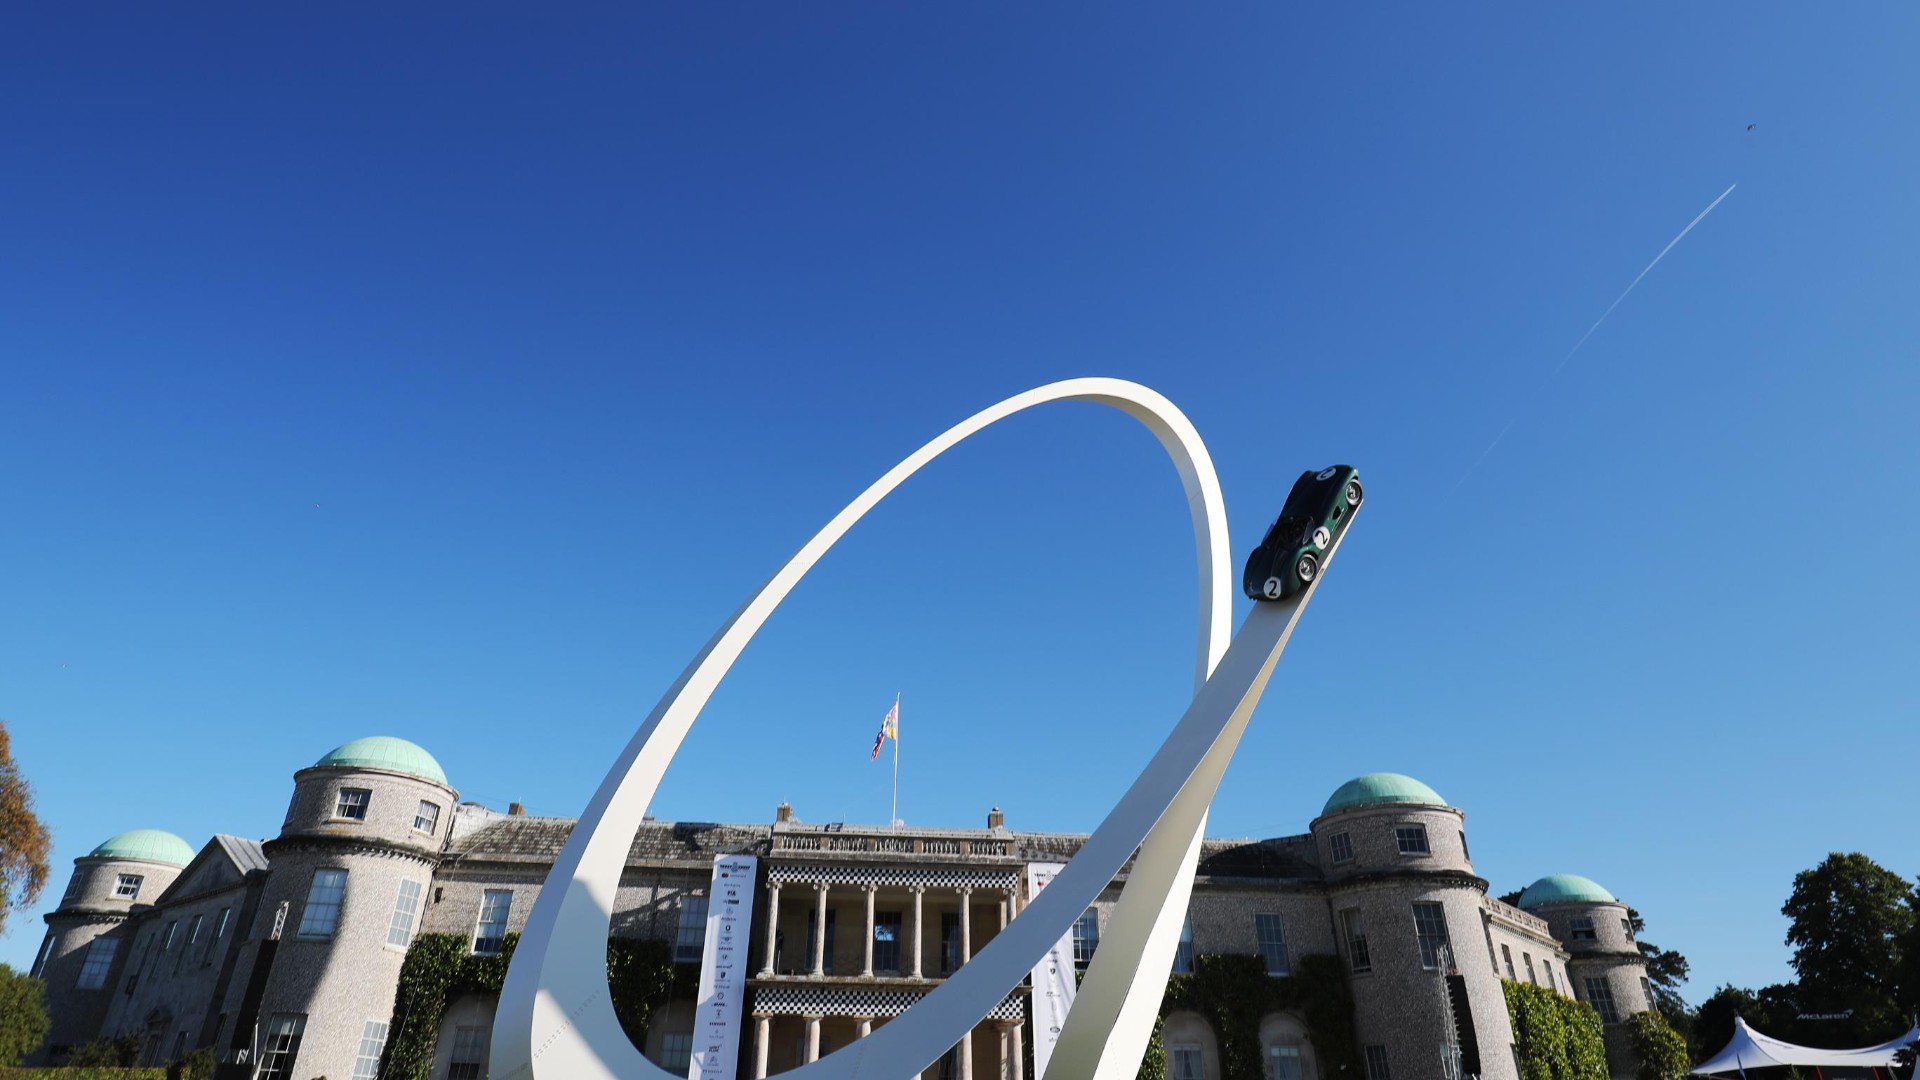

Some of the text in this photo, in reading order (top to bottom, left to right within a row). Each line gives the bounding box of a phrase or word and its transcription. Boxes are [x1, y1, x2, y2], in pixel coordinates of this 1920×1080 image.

[1315, 530, 1328, 545] 2
[1268, 580, 1277, 597] 2
[1796, 1011, 1851, 1020] McLaren
